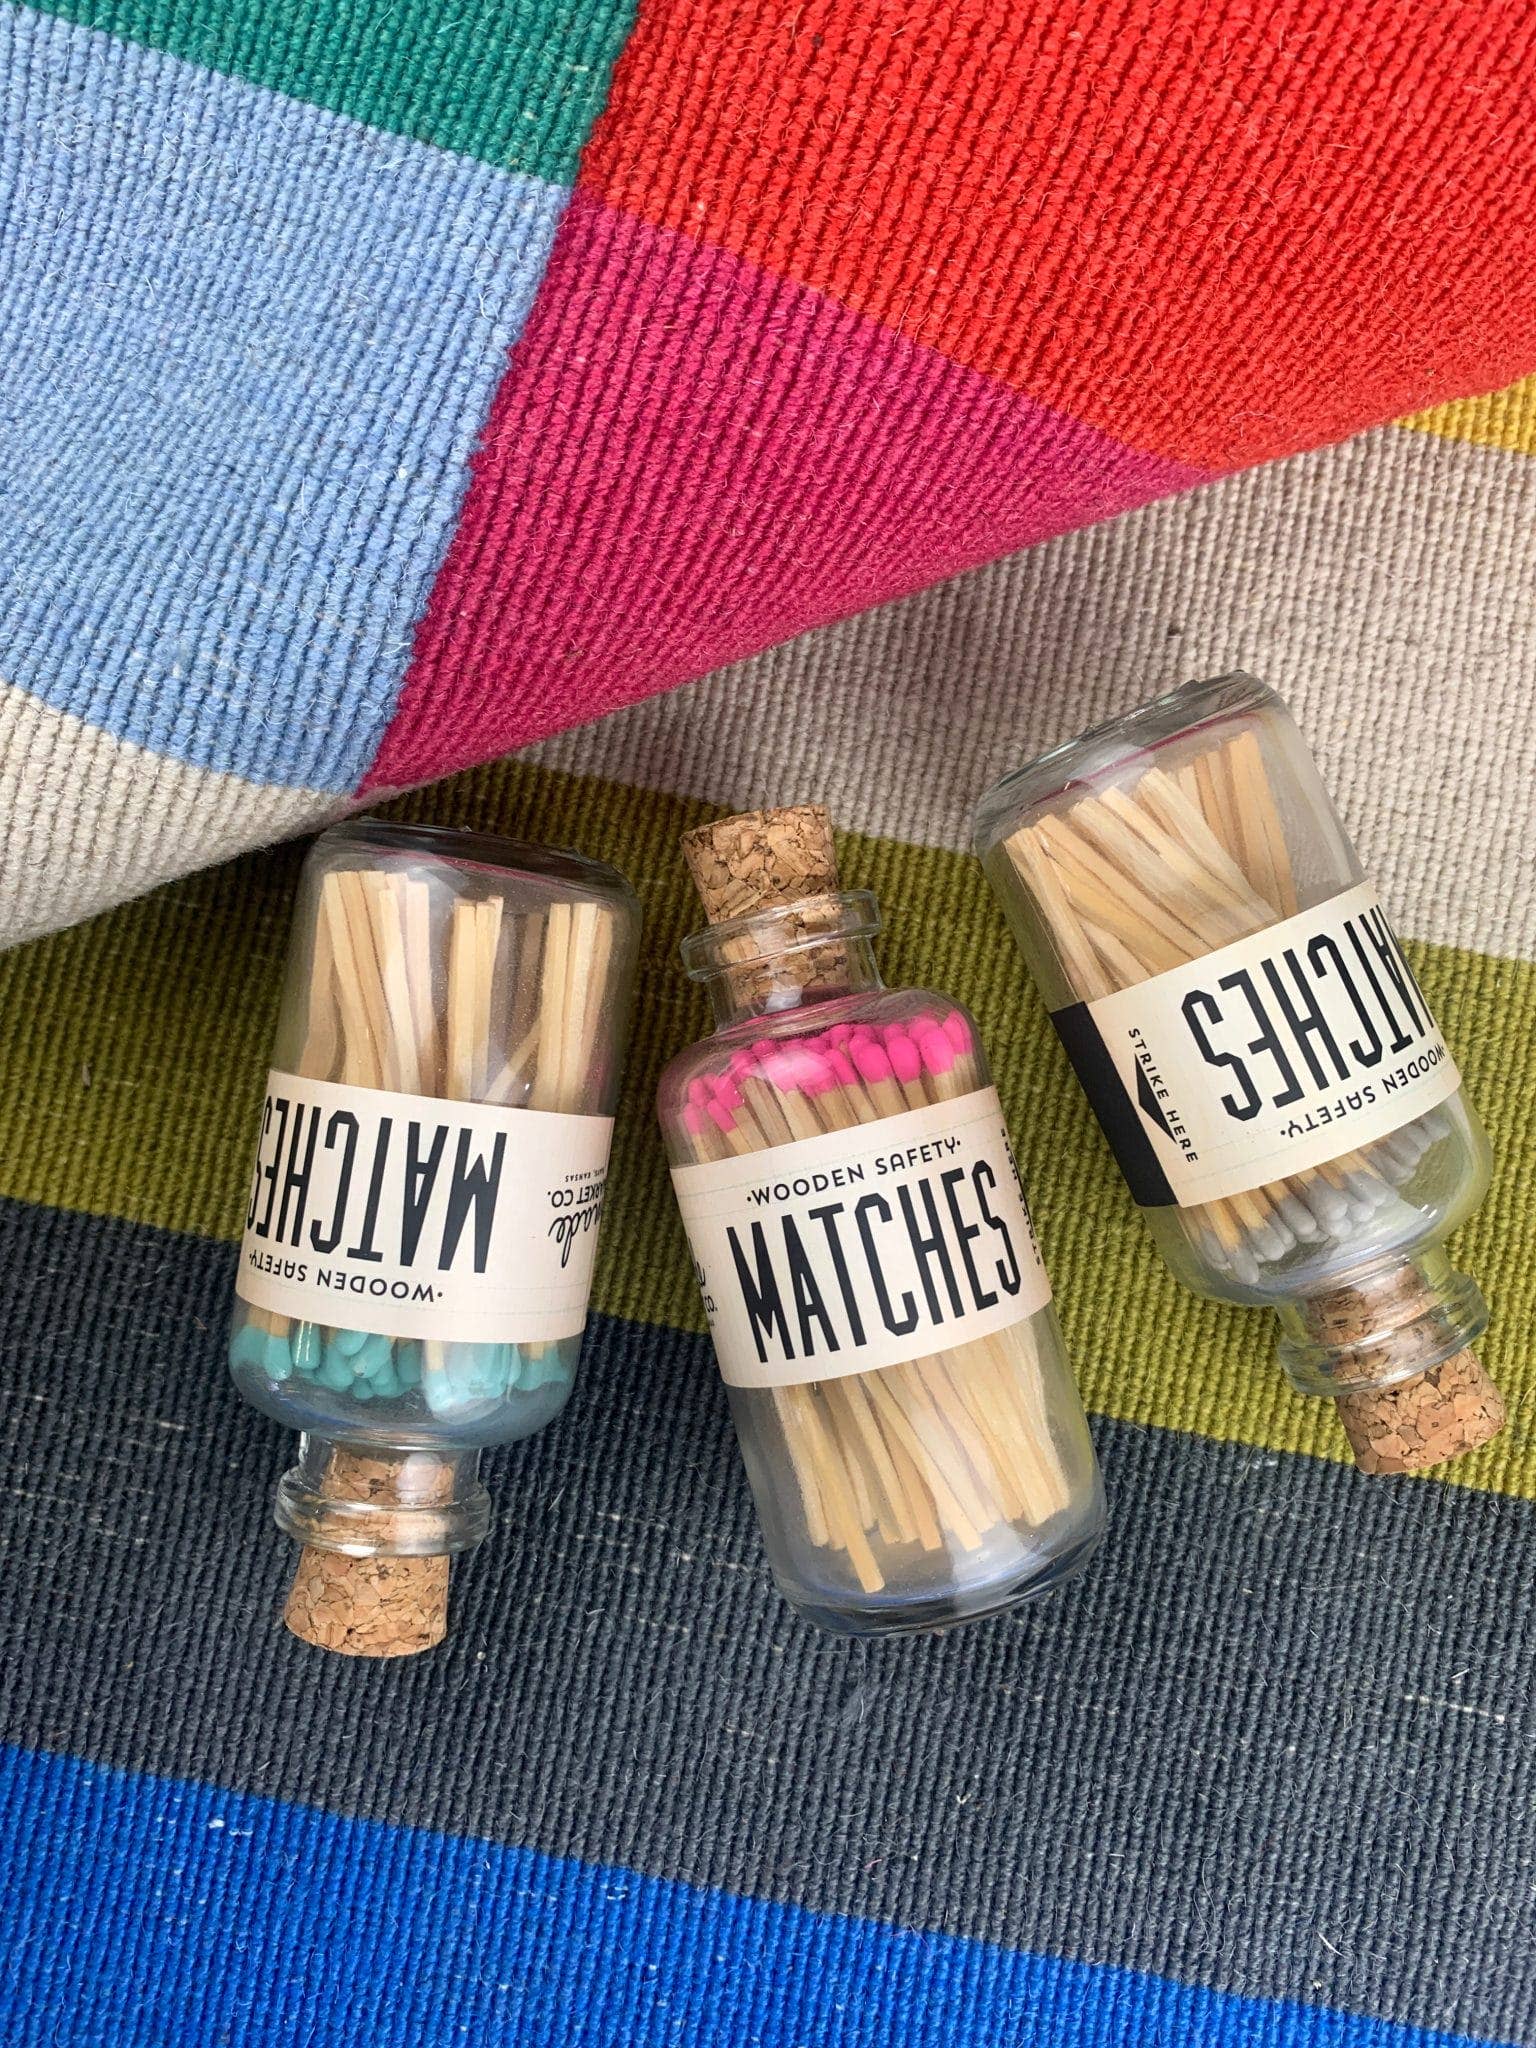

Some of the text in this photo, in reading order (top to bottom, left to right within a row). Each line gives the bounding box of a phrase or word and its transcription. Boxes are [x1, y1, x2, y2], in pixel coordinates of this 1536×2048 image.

[1128, 1027, 1199, 1163] STRIKE HERE
[248, 1096, 507, 1273] MATCHES
[548, 1189, 573, 1208] CO.
[726, 1159, 1021, 1363] MATCHES
